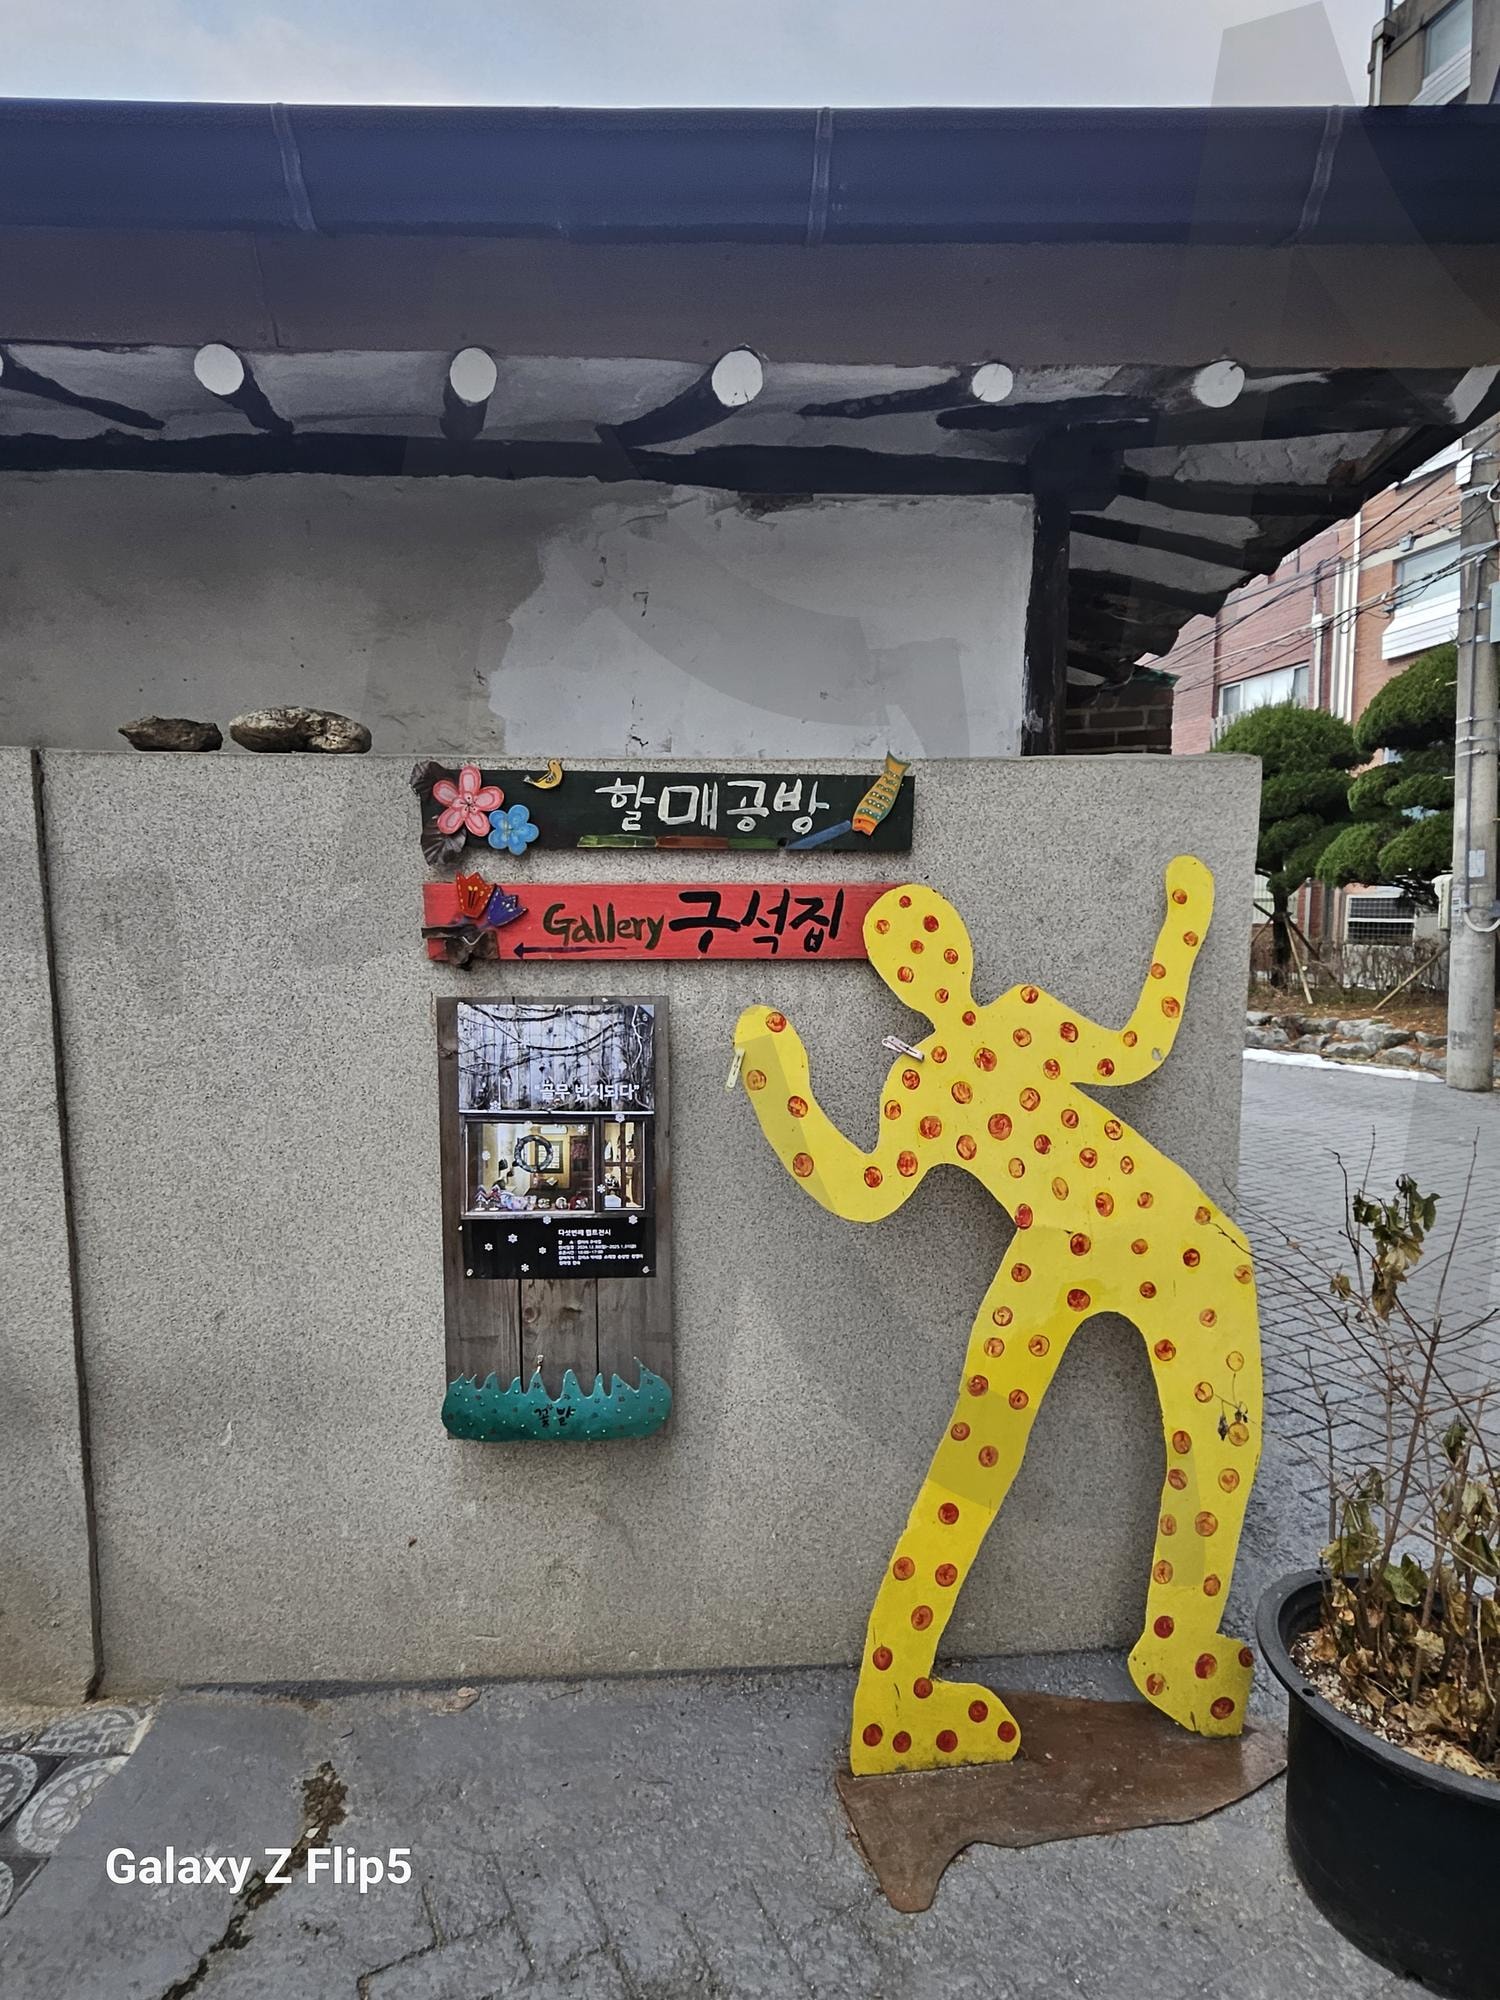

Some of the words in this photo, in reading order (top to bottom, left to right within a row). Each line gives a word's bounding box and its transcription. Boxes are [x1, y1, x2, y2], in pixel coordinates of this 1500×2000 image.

[595, 776, 829, 834] 할매공방
[543, 903, 664, 949] Gallery
[668, 888, 845, 953] 구석집
